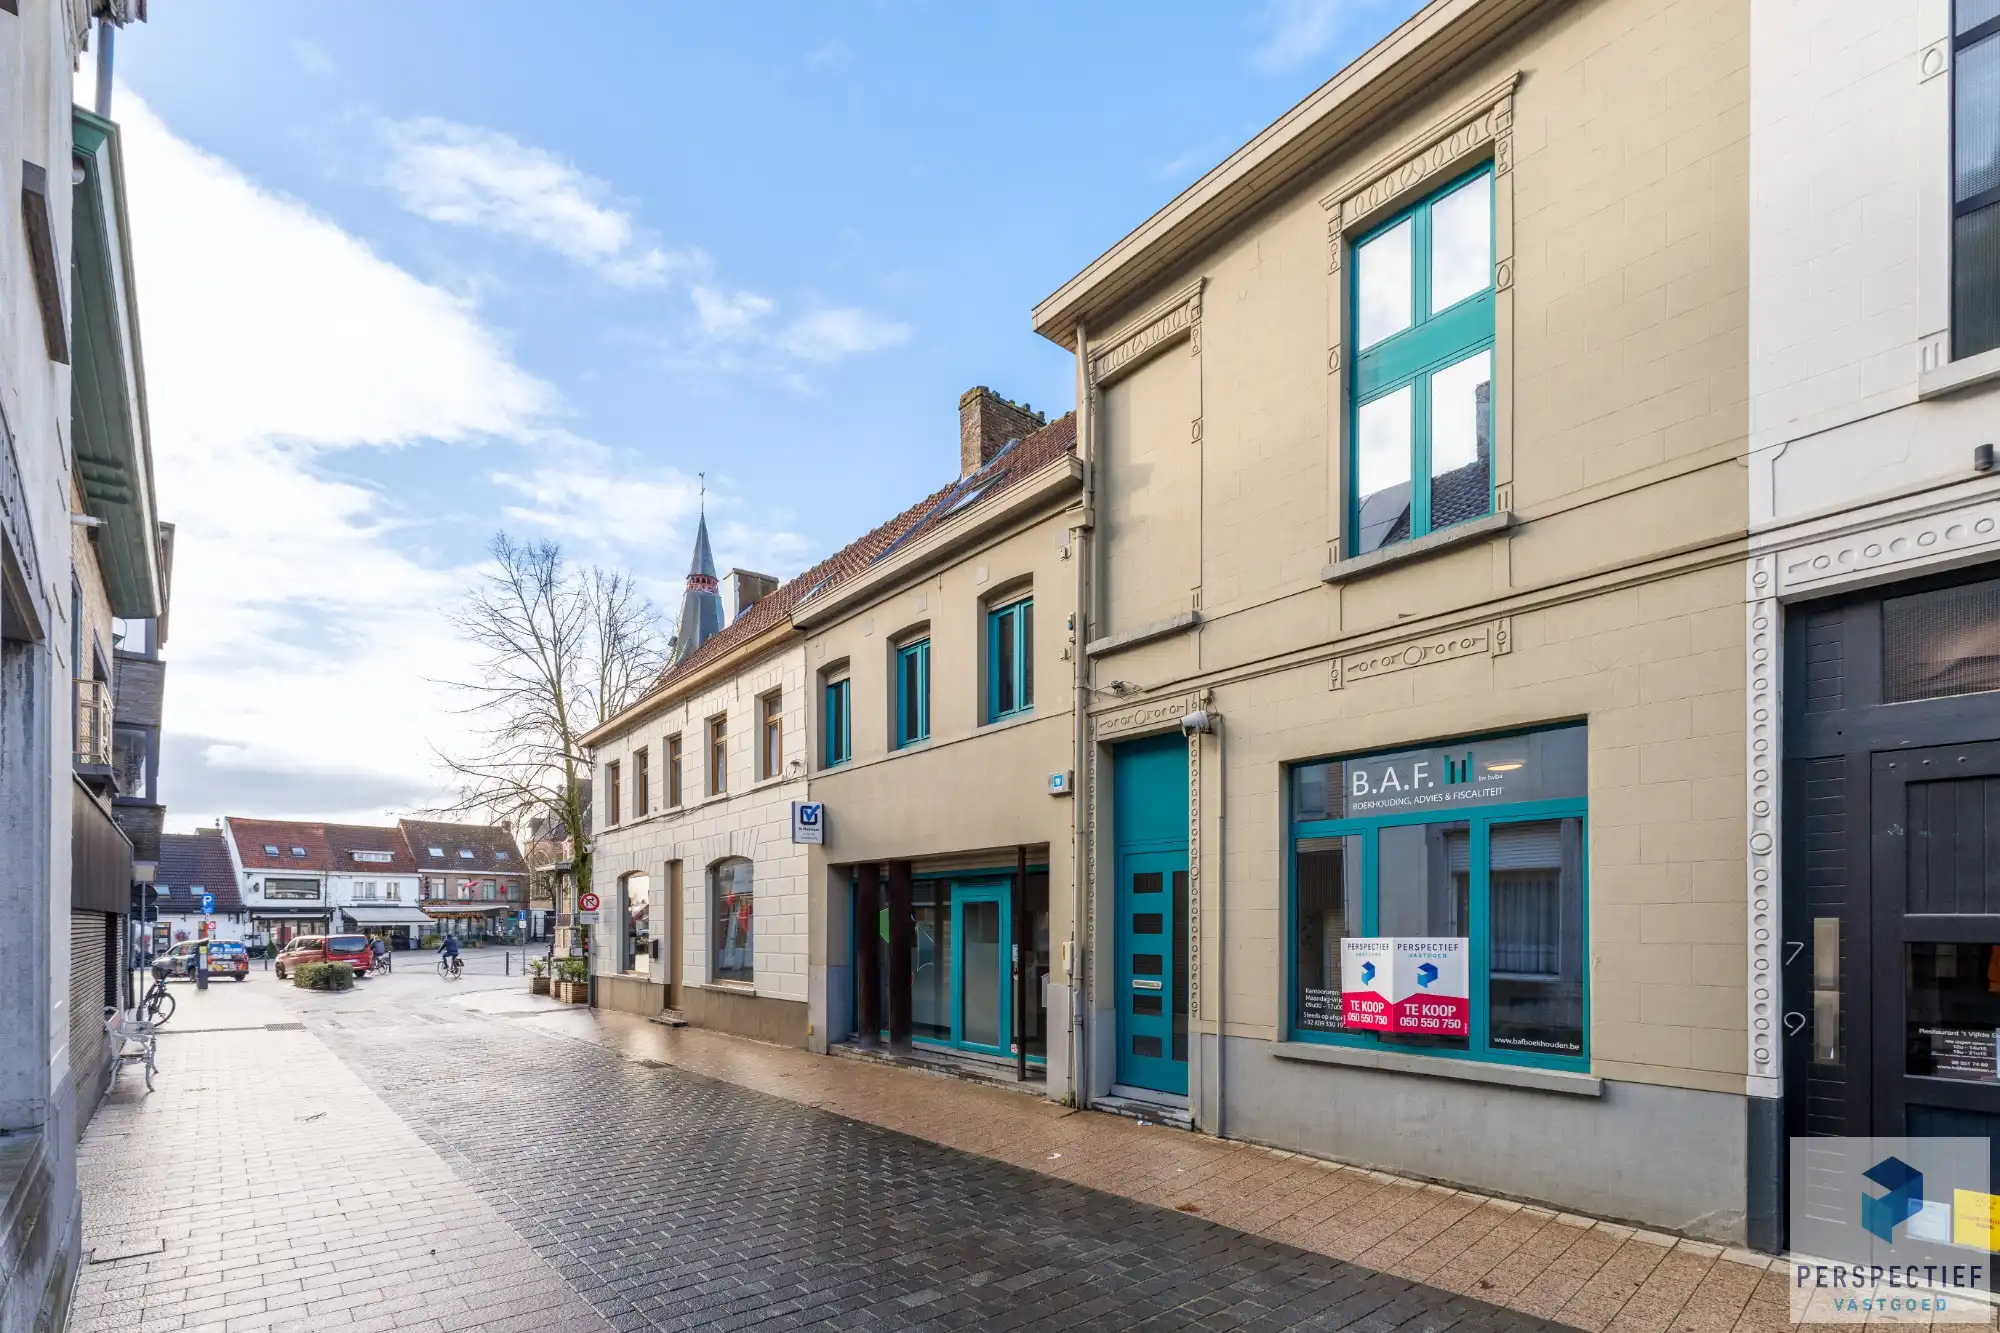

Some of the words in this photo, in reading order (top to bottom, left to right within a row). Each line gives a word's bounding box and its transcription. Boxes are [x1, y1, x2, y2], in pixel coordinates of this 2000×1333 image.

[1352, 761, 1434, 796] B.A.F.
[1352, 797, 1412, 810] BOEKHOUDING,
[1414, 793, 1443, 805] ADVIES
[1444, 792, 1452, 801] &
[1453, 786, 1504, 800] FISCALITEIT
[1347, 942, 1390, 951] PERSPECTIEF
[1397, 943, 1459, 952] PERSPECTIEF
[1786, 941, 1805, 966] 7
[1350, 999, 1360, 1012] TE
[1361, 1000, 1385, 1014] KOOP
[1404, 1003, 1420, 1016] TE
[1422, 1004, 1457, 1017] KOOP
[1347, 1012, 1360, 1023] 050
[1361, 1014, 1374, 1024] 550
[1375, 1015, 1388, 1026] 750
[1400, 1017, 1419, 1028] 050
[1421, 1018, 1440, 1029] 550
[1442, 1019, 1462, 1030] 750
[1784, 1012, 1806, 1037] 9
[1918, 1028, 1959, 1036] Restaurant
[1493, 1037, 1580, 1050] www.bafboekhouden.be
